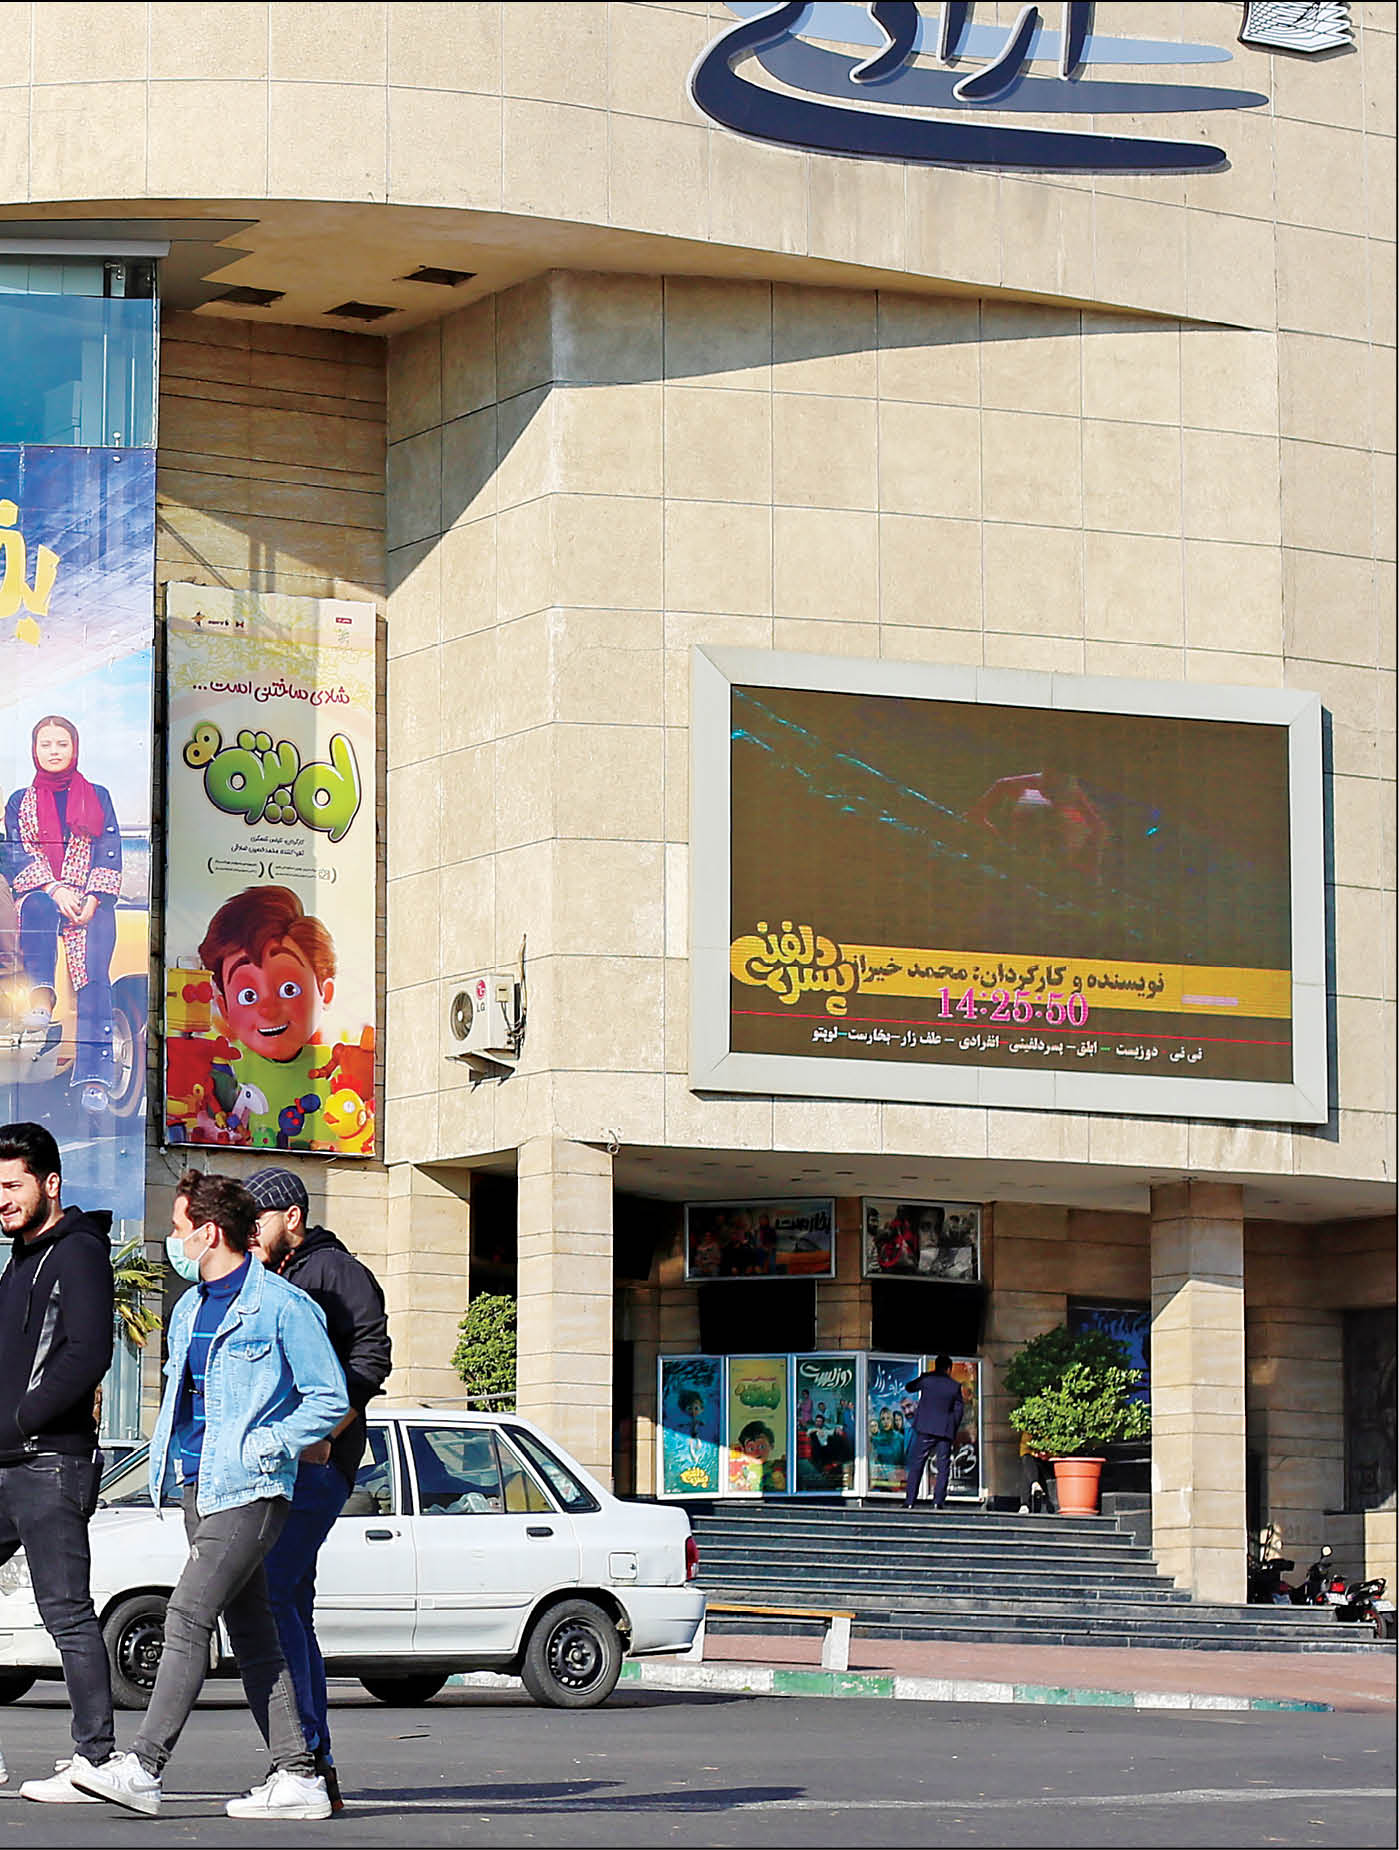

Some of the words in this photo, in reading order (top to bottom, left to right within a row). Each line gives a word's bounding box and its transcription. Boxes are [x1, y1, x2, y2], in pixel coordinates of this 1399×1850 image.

[907, 963, 969, 980] محمد
[1072, 974, 1084, 995] و
[1086, 972, 1166, 999] نویسنده
[476, 1002, 487, 1013] LG
[935, 986, 1090, 1027] 14:25:50
[810, 1025, 839, 1044] لوپتو
[847, 1026, 892, 1046] بخارست
[899, 1029, 918, 1048] زار
[919, 1030, 942, 1045] علف
[958, 1033, 1001, 1052] انفرادی
[1075, 1039, 1098, 1058] ابلق
[1114, 1042, 1160, 1061] دوزیست
